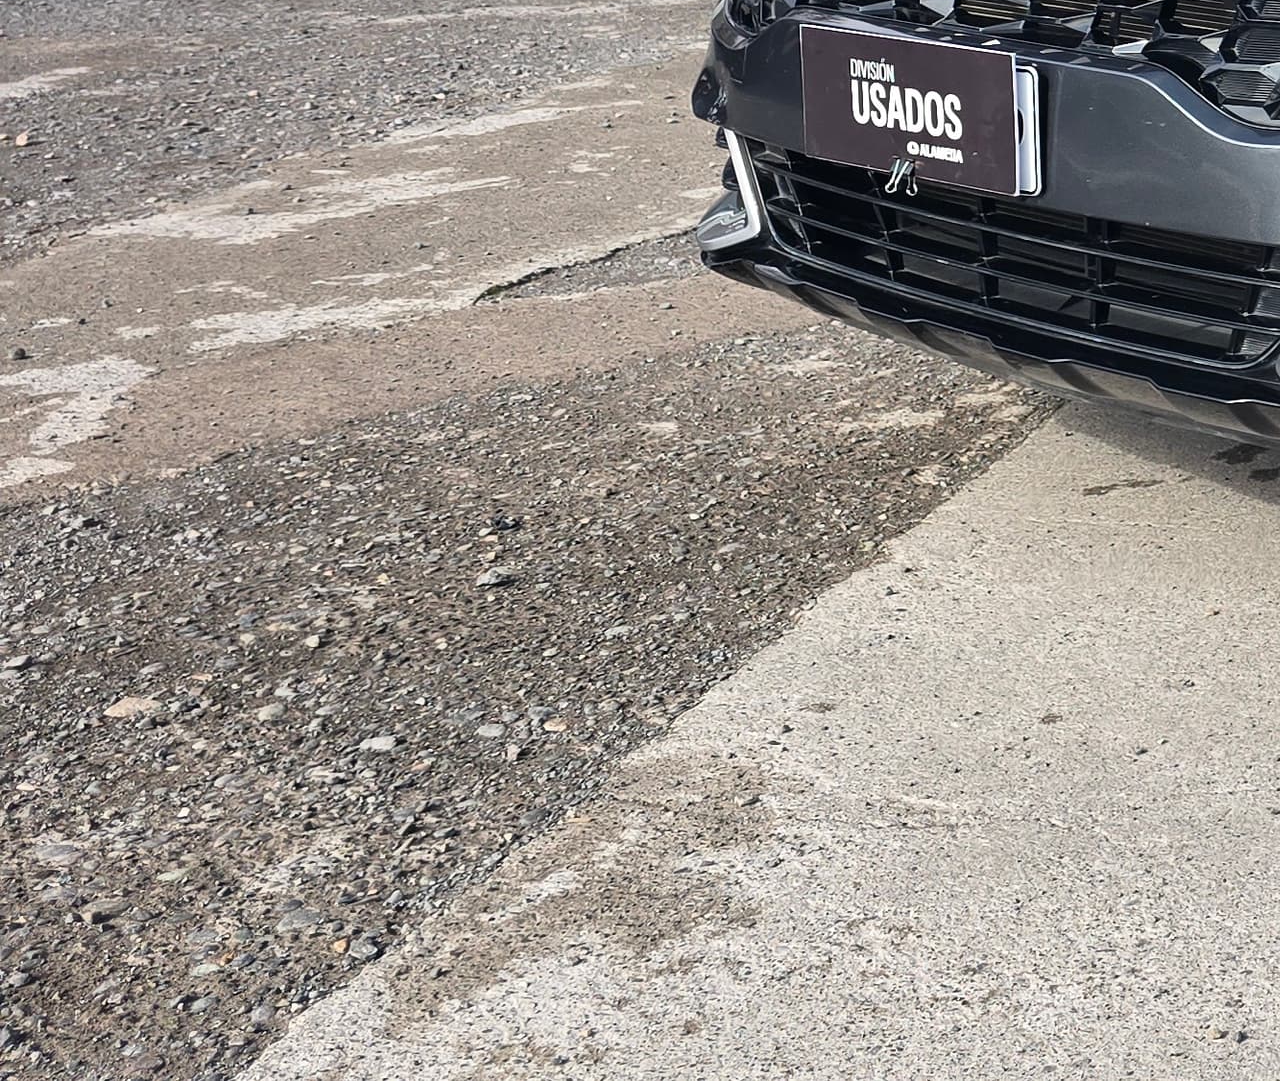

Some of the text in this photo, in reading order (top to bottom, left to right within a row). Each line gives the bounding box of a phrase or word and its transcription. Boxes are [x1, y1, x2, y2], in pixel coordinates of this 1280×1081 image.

[850, 57, 895, 84] DIVISIÓN
[851, 79, 963, 141] USADOS
[919, 143, 964, 164] ALAMEDA
